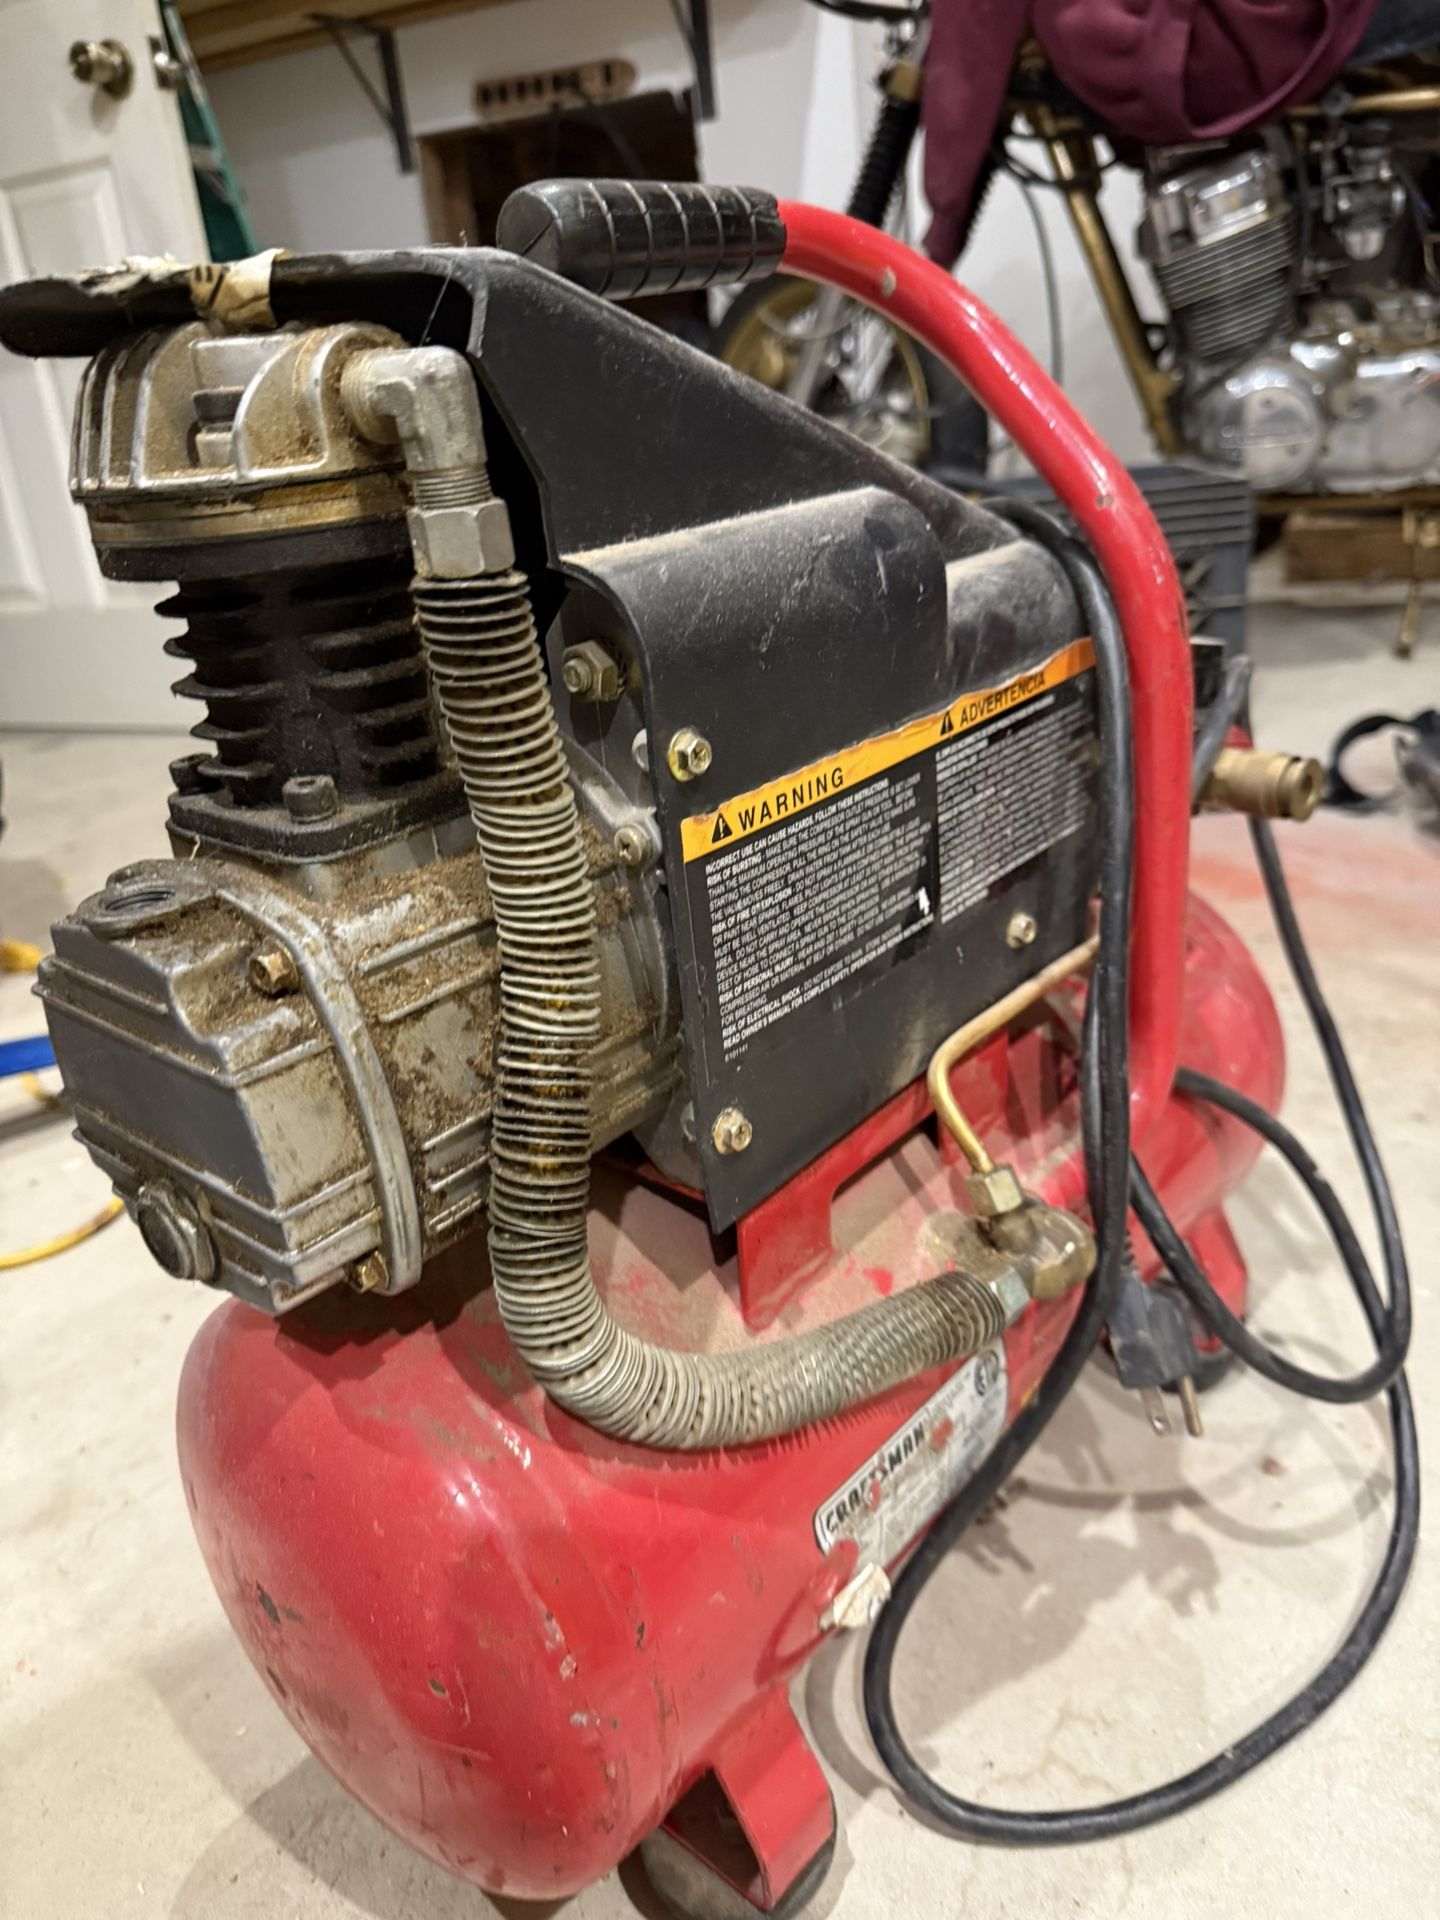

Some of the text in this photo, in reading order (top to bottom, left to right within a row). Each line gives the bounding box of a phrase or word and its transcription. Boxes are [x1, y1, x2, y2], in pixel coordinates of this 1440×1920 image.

[960, 671, 1045, 728] ADVERTENCIA
[738, 767, 844, 831] WARNING
[705, 848, 740, 875] INCORRECT
[740, 842, 753, 857] USE
[753, 836, 766, 851] CAN
[767, 826, 786, 845] CAUSE
[706, 871, 721, 887] RISK
[722, 866, 731, 880] OF
[731, 851, 761, 875] BURSTING
[708, 882, 724, 900] THAN
[725, 876, 737, 891] THE
[738, 862, 765, 885] MAXIMUM
[709, 888, 738, 912] STARTING
[739, 881, 751, 896] THE
[710, 908, 723, 924] THE
[723, 899, 742, 917] VALVE
[742, 888, 763, 908] MOVES
[711, 919, 726, 936] RISK
[727, 914, 736, 928] OF
[736, 907, 750, 923] FIRE
[712, 934, 722, 948] OR
[723, 924, 740, 943] PAINT
[741, 915, 757, 933] NEAR
[714, 941, 731, 960] MUST
[731, 936, 740, 950] BE
[741, 928, 756, 945] WELL
[735, 946, 745, 960] DO
[745, 939, 758, 955] NOT
[716, 962, 739, 984] DEVICE
[739, 953, 755, 971] NEAR
[717, 977, 732, 995] FEET
[733, 972, 742, 986] OF
[743, 962, 759, 981] HOSE
[718, 989, 733, 1006] RISK
[733, 983, 742, 997] OF
[743, 966, 773, 992] PERSONAL
[719, 985, 760, 1018] COMPRESSED
[721, 1012, 734, 1029] FOR
[722, 1022, 737, 1040] RISK
[737, 1017, 745, 1031] OF
[746, 996, 780, 1025] ELECTRICAL
[723, 1032, 740, 1051] READ
[768, 1001, 790, 1024] MANUAL
[791, 994, 802, 1010] FOR
